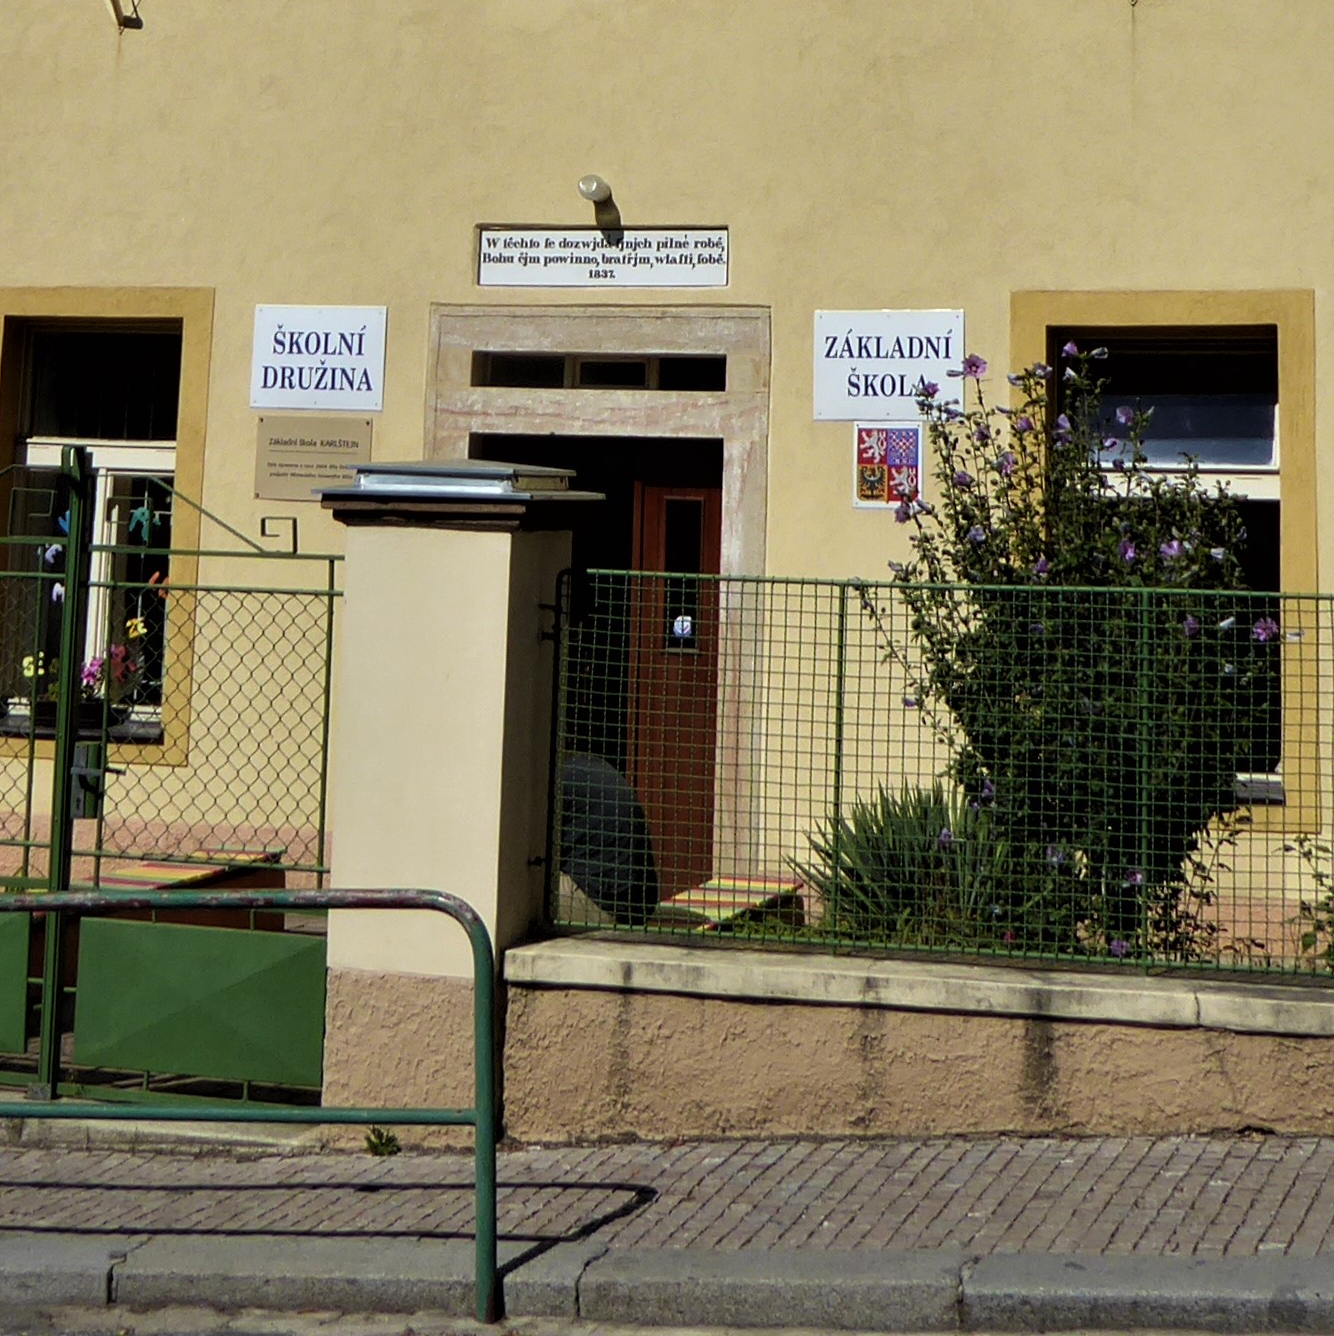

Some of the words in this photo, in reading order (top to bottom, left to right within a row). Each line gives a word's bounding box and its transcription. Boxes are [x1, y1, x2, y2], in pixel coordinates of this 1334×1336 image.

[482, 252, 515, 264] Bohu
[486, 237, 500, 249] W
[273, 324, 366, 356] ŠKOLNÍ
[825, 328, 953, 359] ZÁKLADNÍ
[261, 359, 373, 391] DRUŽINA
